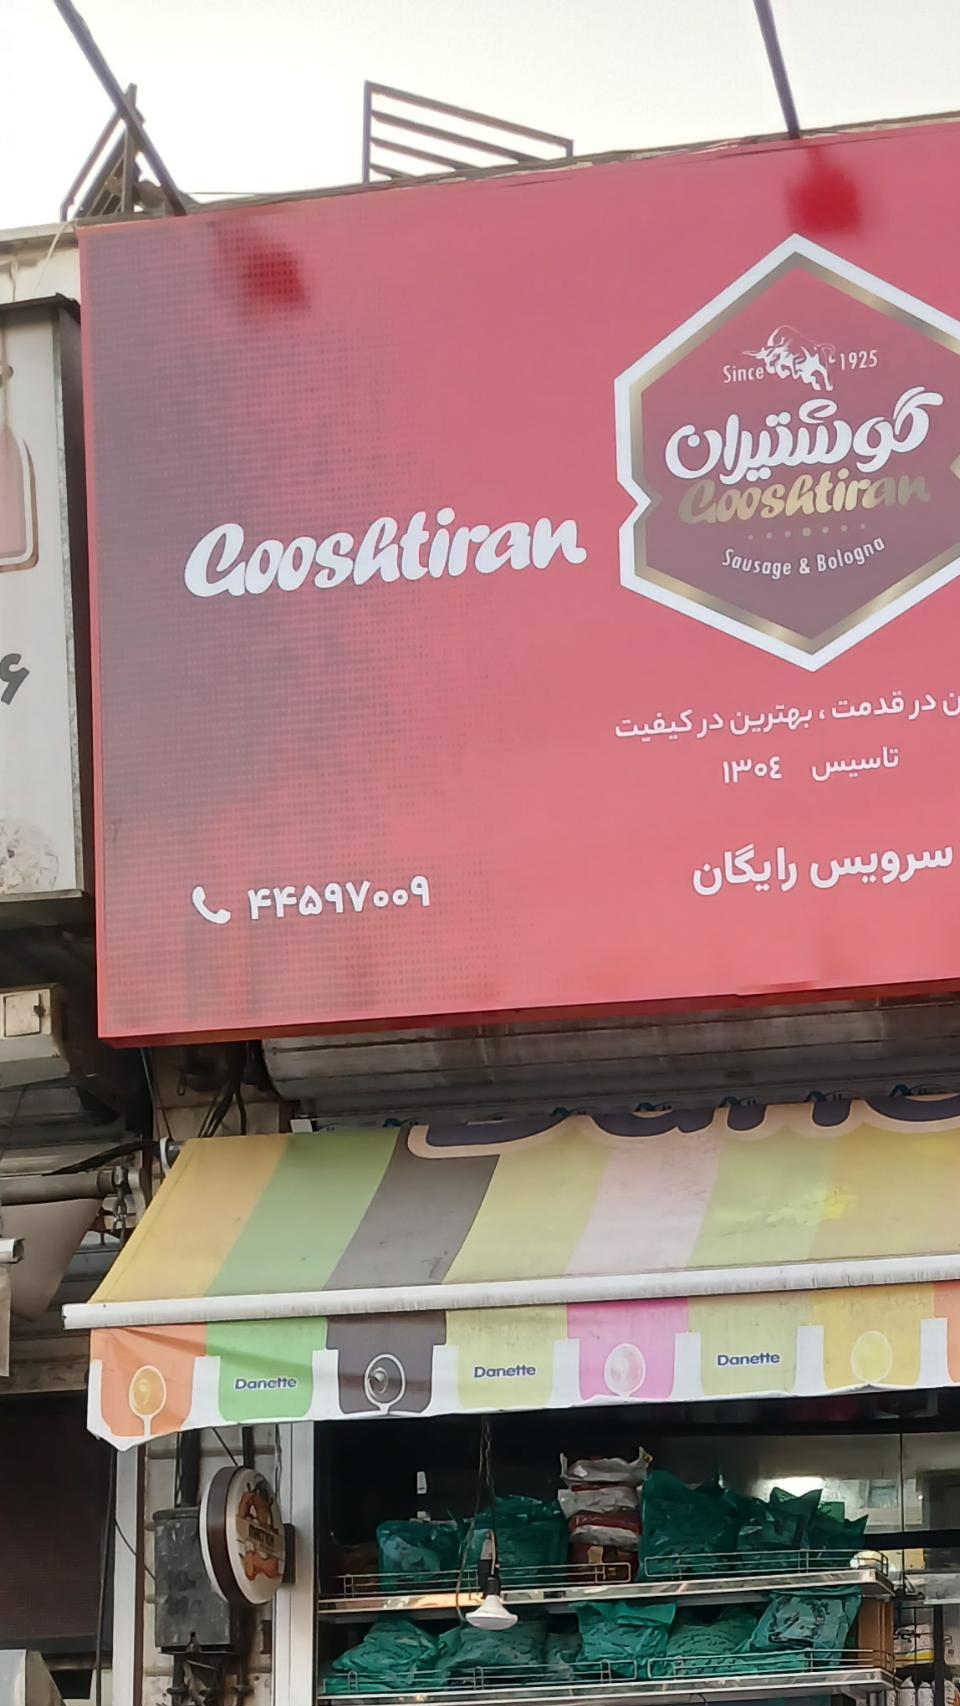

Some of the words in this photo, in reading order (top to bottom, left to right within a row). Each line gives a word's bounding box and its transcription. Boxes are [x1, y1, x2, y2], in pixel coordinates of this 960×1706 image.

[723, 364, 765, 384] Since
[840, 350, 878, 371] 1925
[664, 386, 944, 485] گوشتیران
[722, 548, 792, 579] Sausage
[799, 558, 811, 574] &
[816, 536, 885, 572] Bologna
[730, 704, 813, 735] بهترین
[831, 690, 904, 719] قدمت
[908, 694, 936, 720] در
[615, 709, 692, 742] کیفیت
[697, 713, 724, 738] در
[811, 746, 900, 781] تاسیس
[692, 843, 798, 895] رایگان
[809, 844, 953, 889] سرویس
[247, 876, 431, 920] ۴۴۵۹۷۰۰۹
[473, 1361, 537, 1380] Danette
[716, 1350, 781, 1368] Danette
[234, 1374, 298, 1393] Danette
